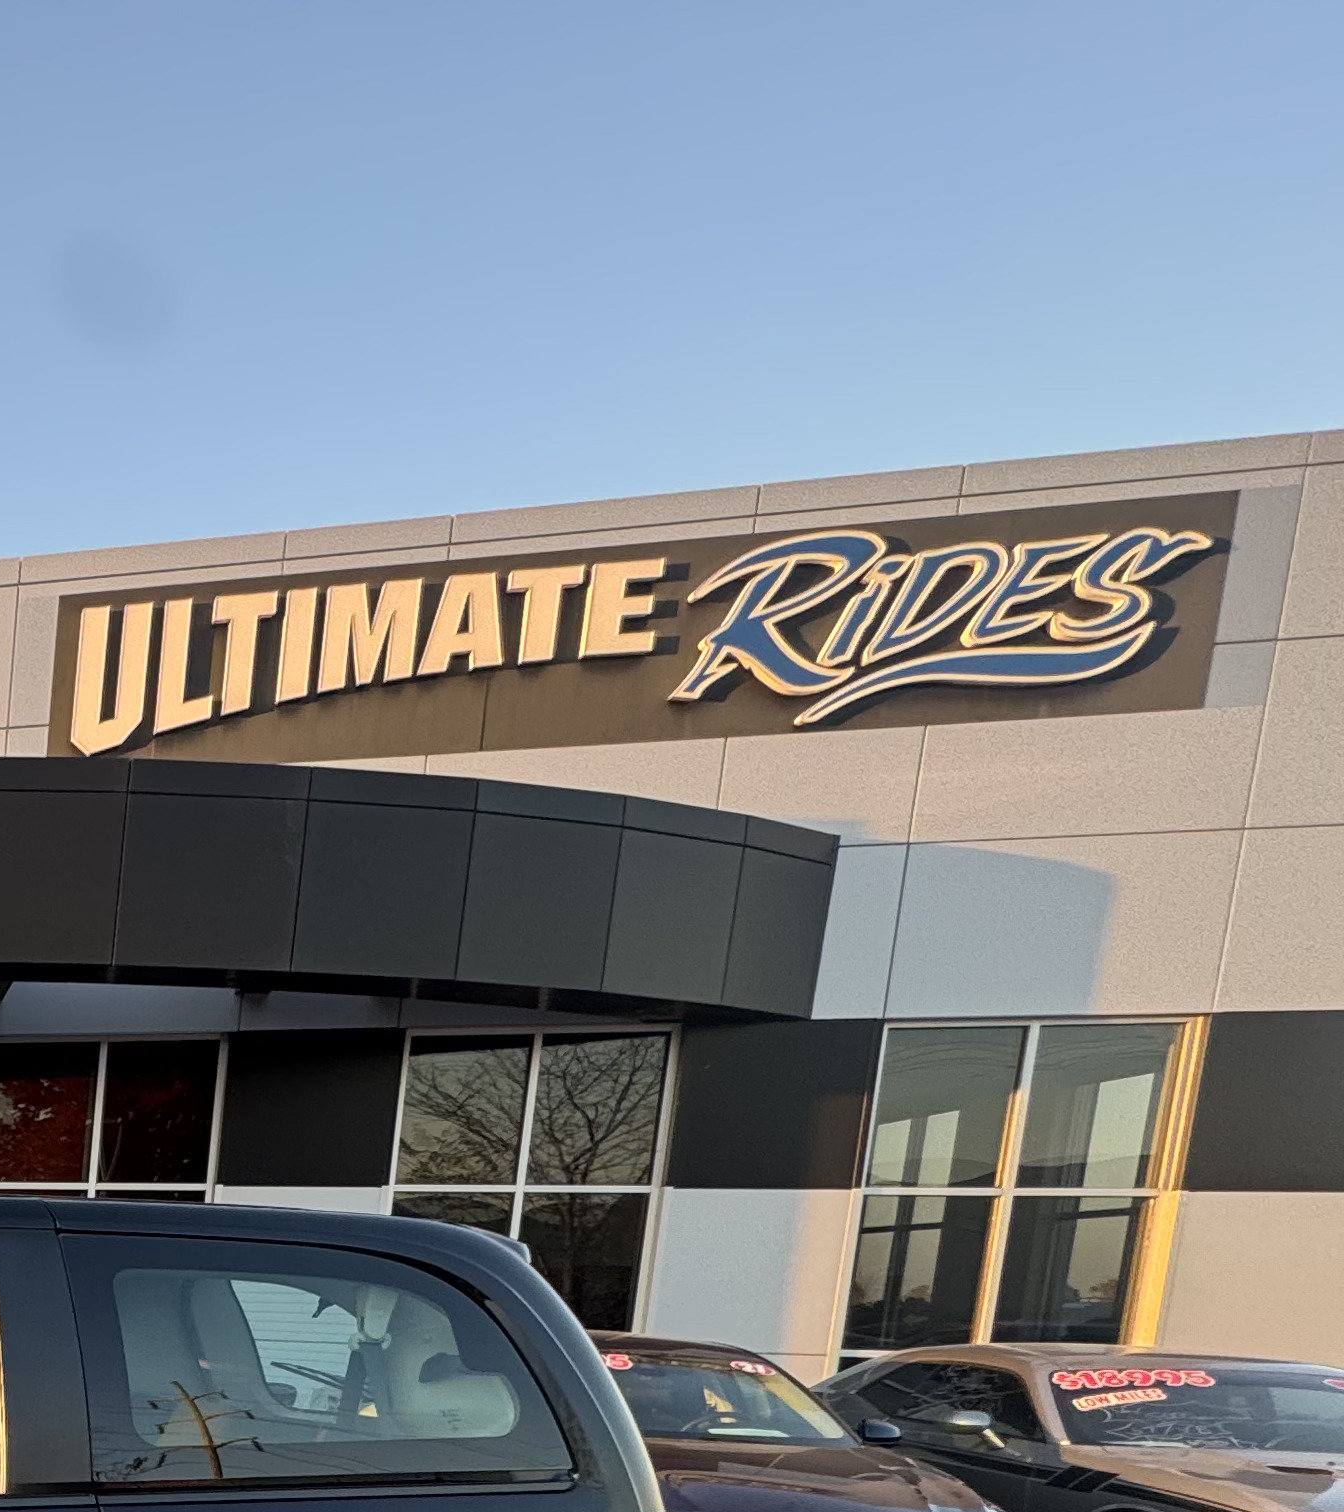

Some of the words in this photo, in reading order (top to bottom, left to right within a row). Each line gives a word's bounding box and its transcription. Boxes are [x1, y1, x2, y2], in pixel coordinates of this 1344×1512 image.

[70, 557, 667, 756] ULTIMATE
[1052, 1369, 1216, 1391] $18995
[1076, 1396, 1109, 1410] LOW
